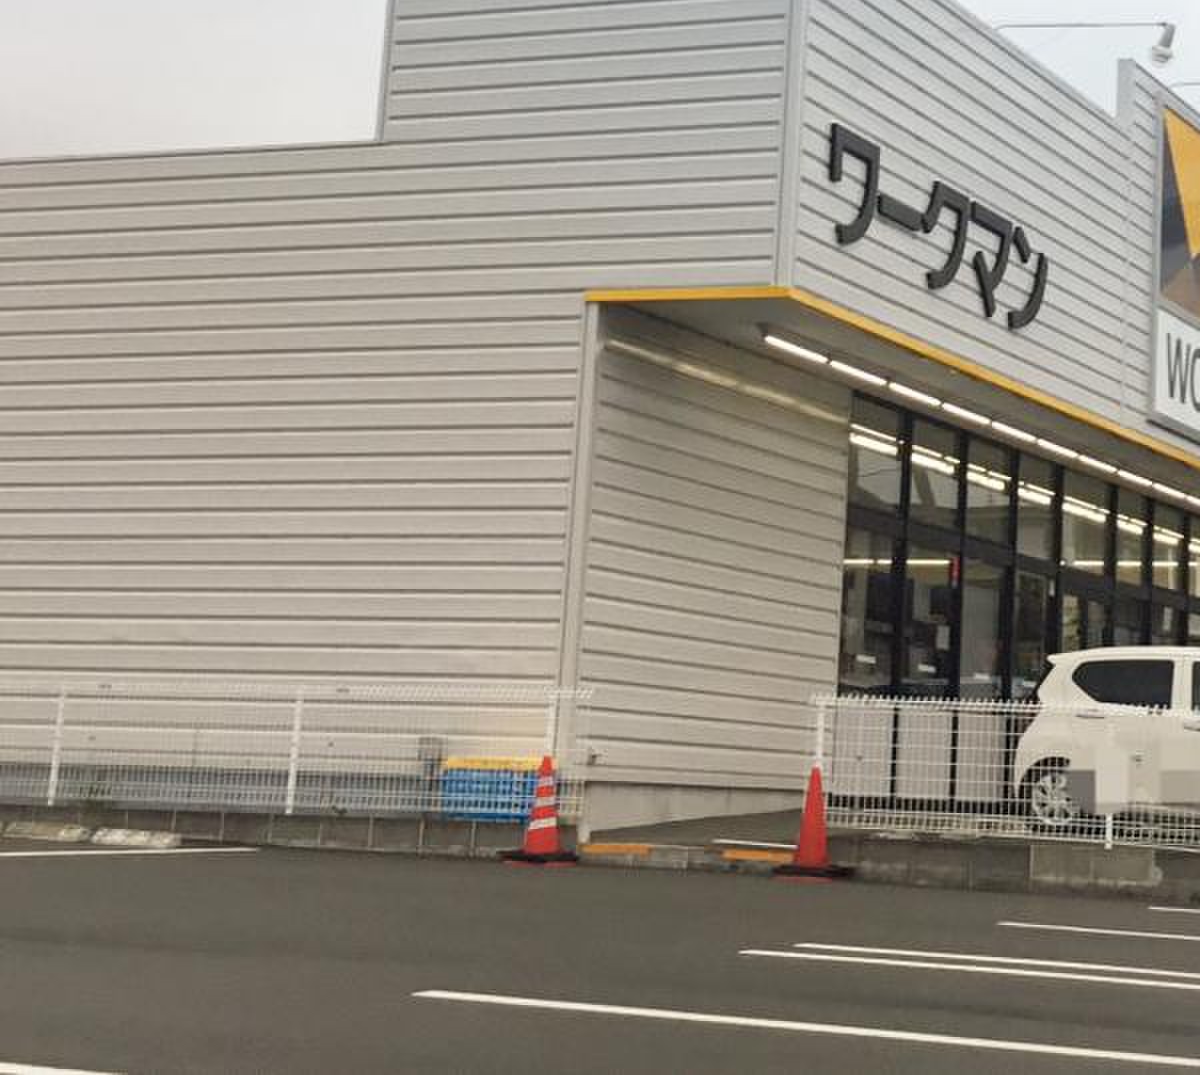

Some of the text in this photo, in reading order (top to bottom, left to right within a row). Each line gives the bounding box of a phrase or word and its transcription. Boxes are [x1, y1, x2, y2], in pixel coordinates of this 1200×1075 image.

[830, 123, 1048, 331] ワークマン
